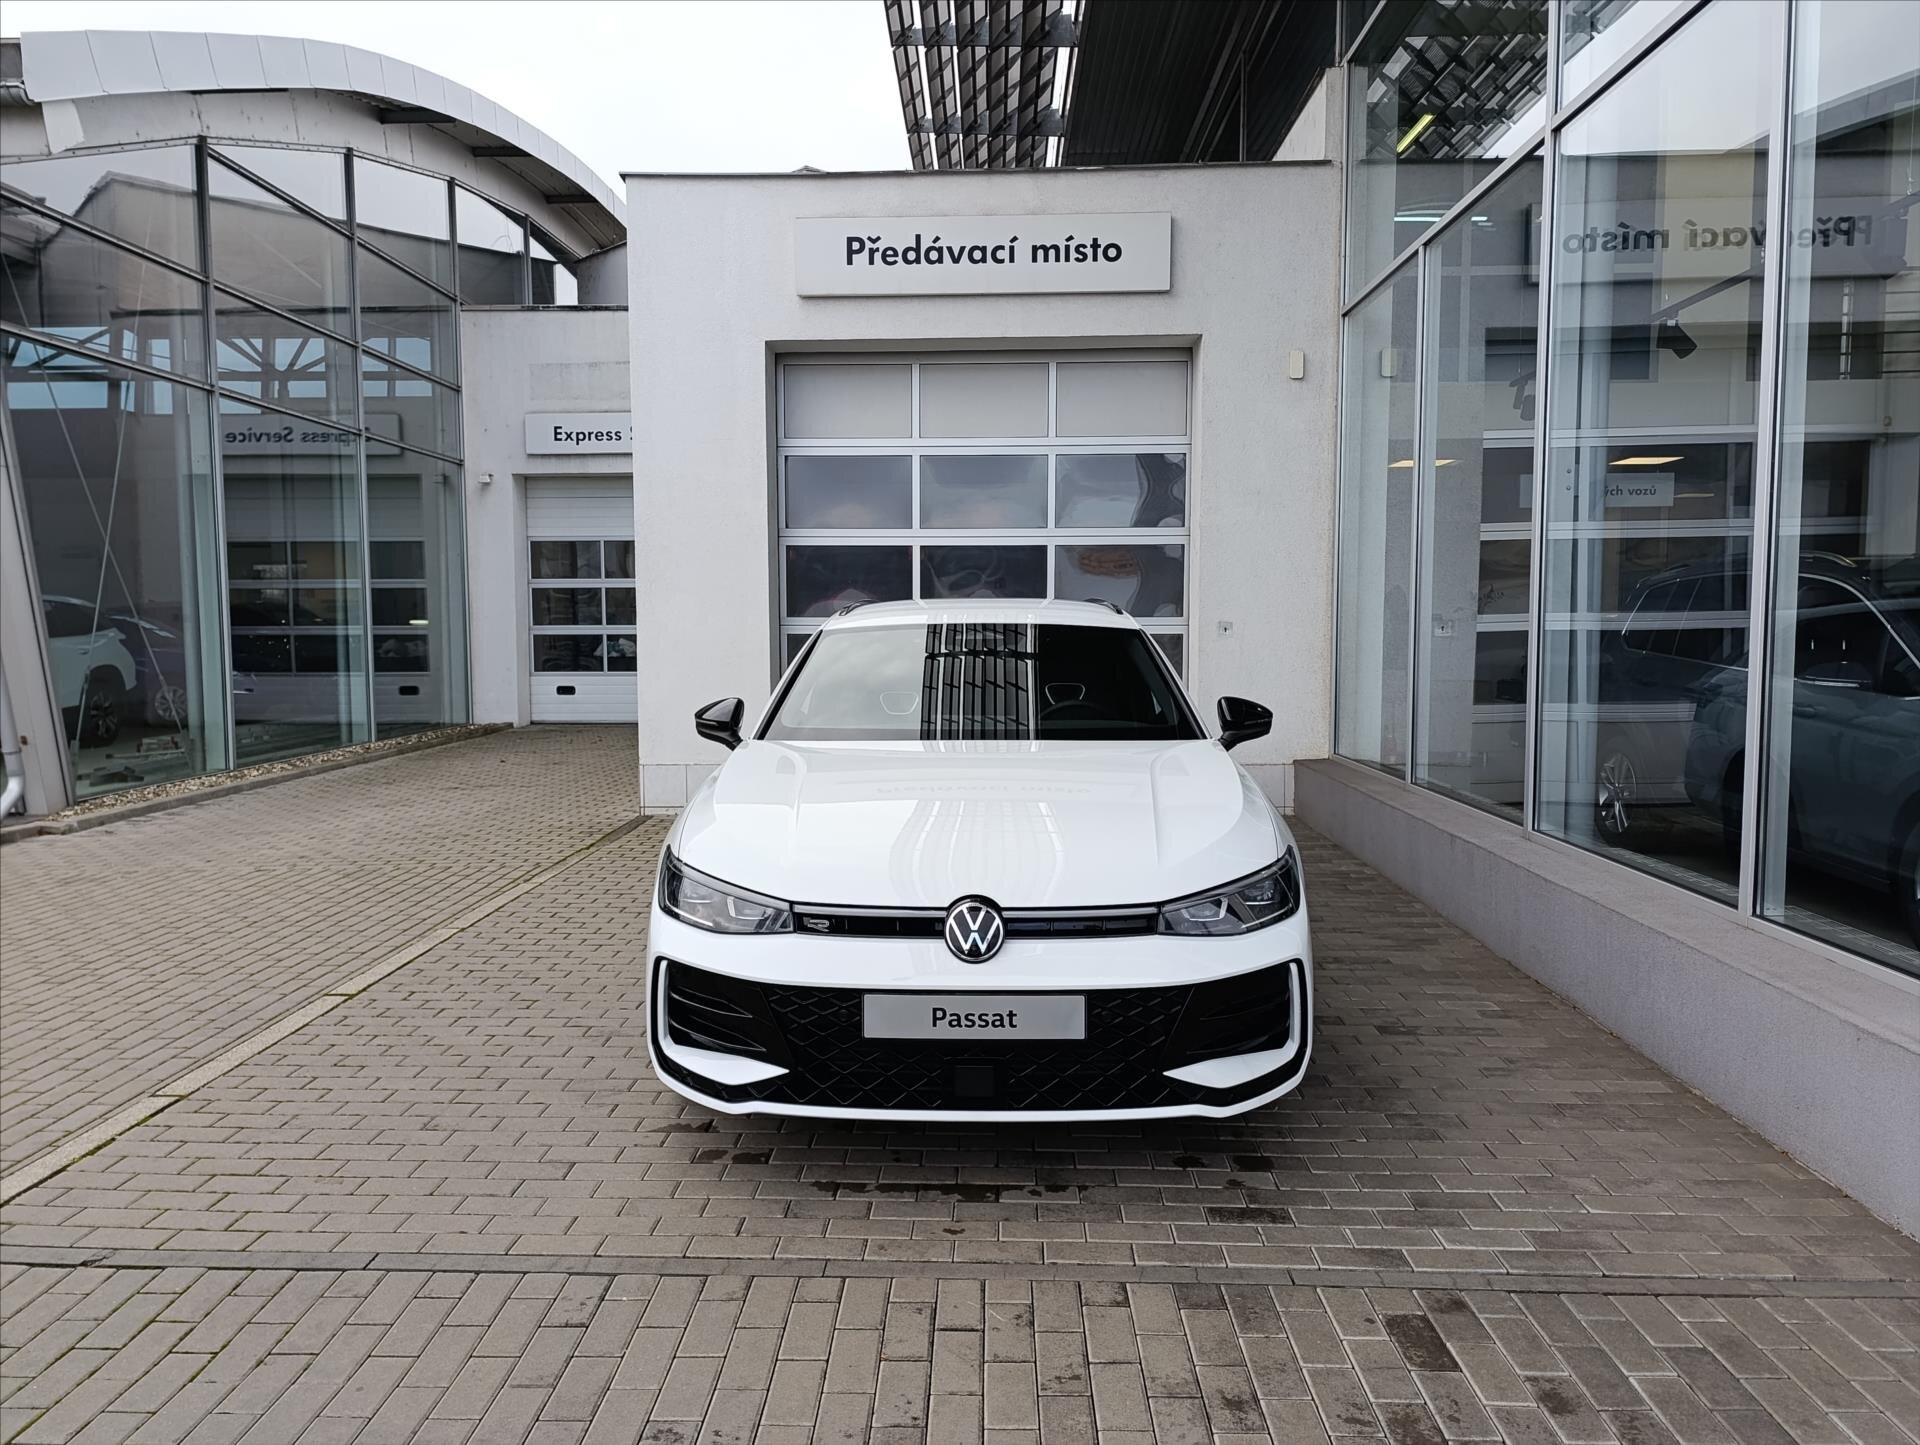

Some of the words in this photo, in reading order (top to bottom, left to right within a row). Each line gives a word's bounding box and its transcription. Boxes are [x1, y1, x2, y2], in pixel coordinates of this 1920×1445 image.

[846, 233, 1019, 266] Předávací
[1031, 234, 1123, 263] místo
[553, 425, 622, 445] Express
[1628, 485, 1657, 496] vozů
[946, 900, 1004, 962] VW
[931, 1007, 1018, 1029] Passat
